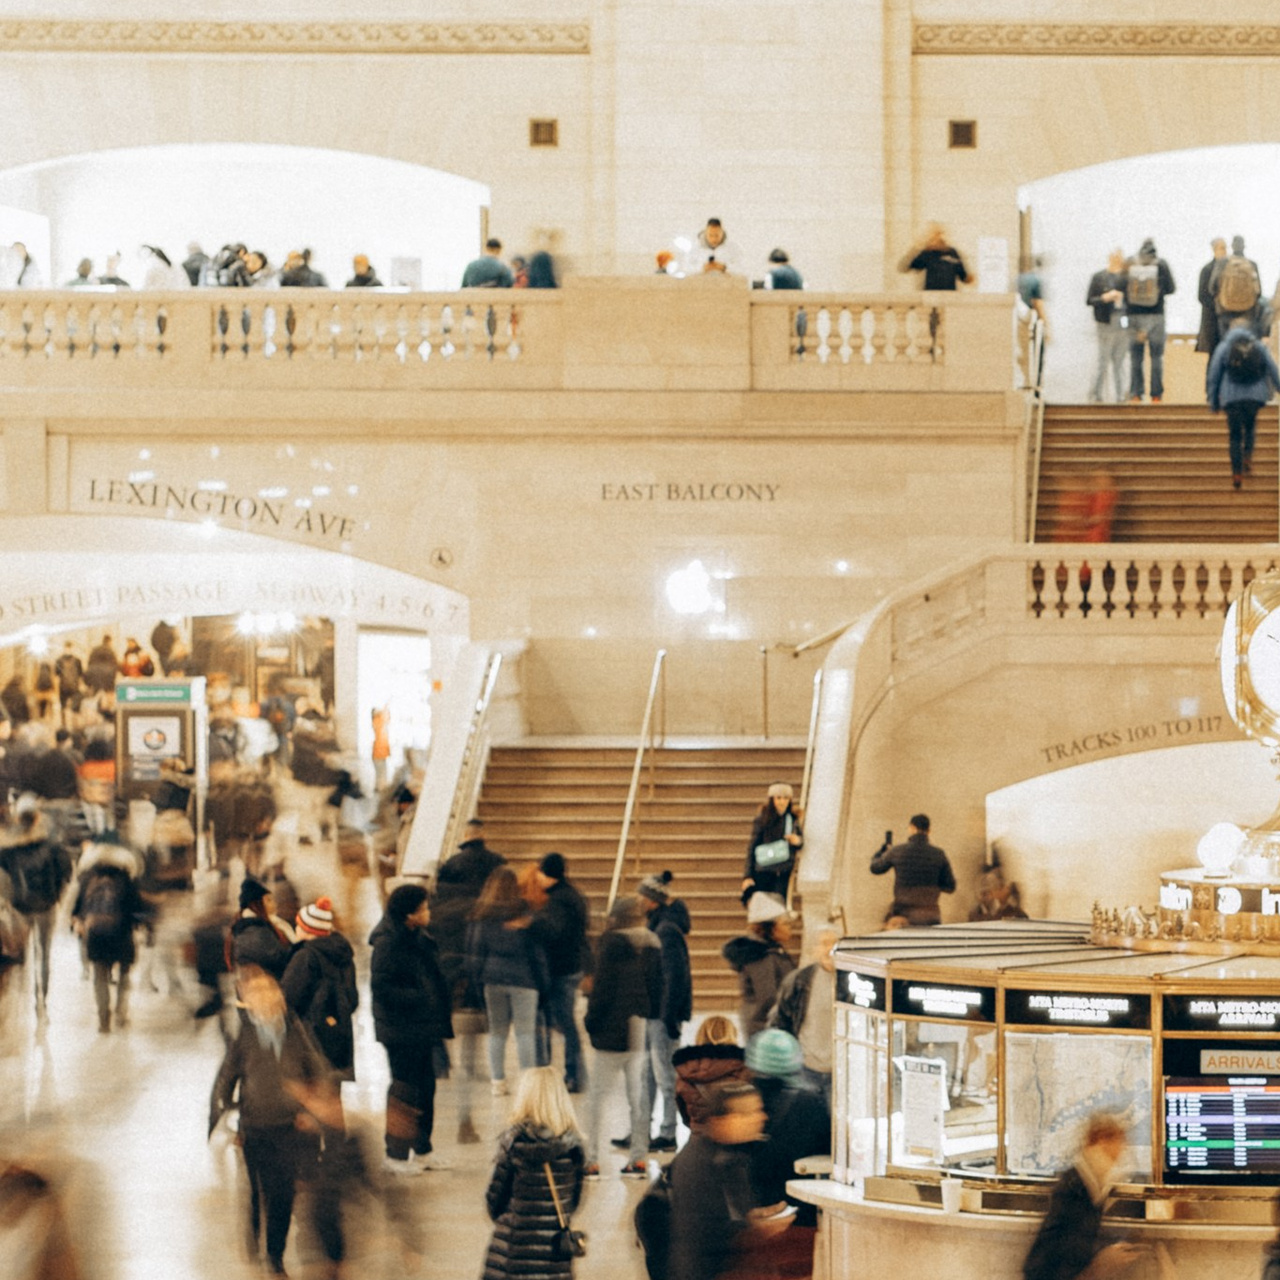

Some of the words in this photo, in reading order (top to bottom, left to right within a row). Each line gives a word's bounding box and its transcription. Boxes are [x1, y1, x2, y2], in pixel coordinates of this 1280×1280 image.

[89, 479, 284, 525] LEXINGTON
[295, 509, 357, 538] AVE
[602, 483, 659, 501] EAST
[667, 483, 780, 501] BALCONY
[12, 587, 104, 617] STREET
[117, 579, 229, 604] PASSAGE
[1041, 729, 1123, 764] TRACKS
[1128, 724, 1157, 743] 100
[1163, 719, 1192, 737] TO
[1198, 716, 1223, 733] 117
